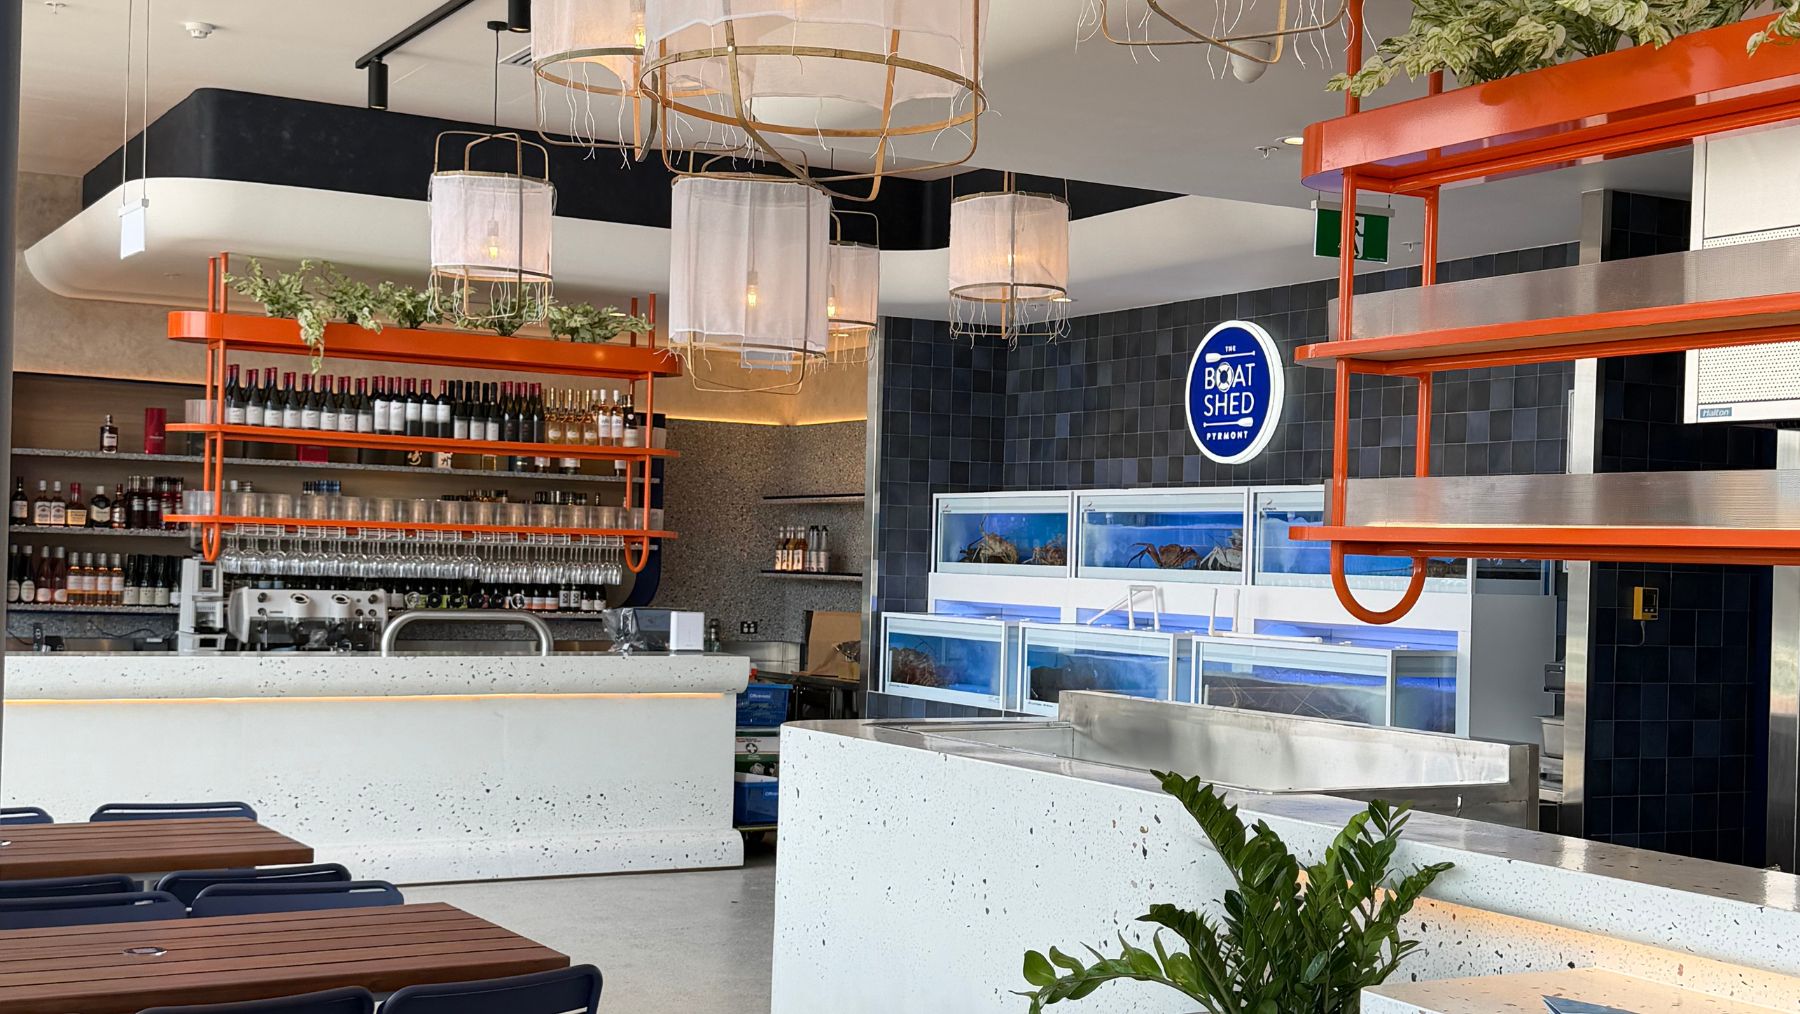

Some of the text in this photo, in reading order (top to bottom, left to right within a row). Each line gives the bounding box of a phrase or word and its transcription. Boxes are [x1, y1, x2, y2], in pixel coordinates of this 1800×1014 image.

[1204, 362, 1256, 392] BOAT
[1203, 392, 1255, 417] SHED
[1702, 409, 1729, 417] Halton
[1206, 430, 1248, 440] PYRMONT
